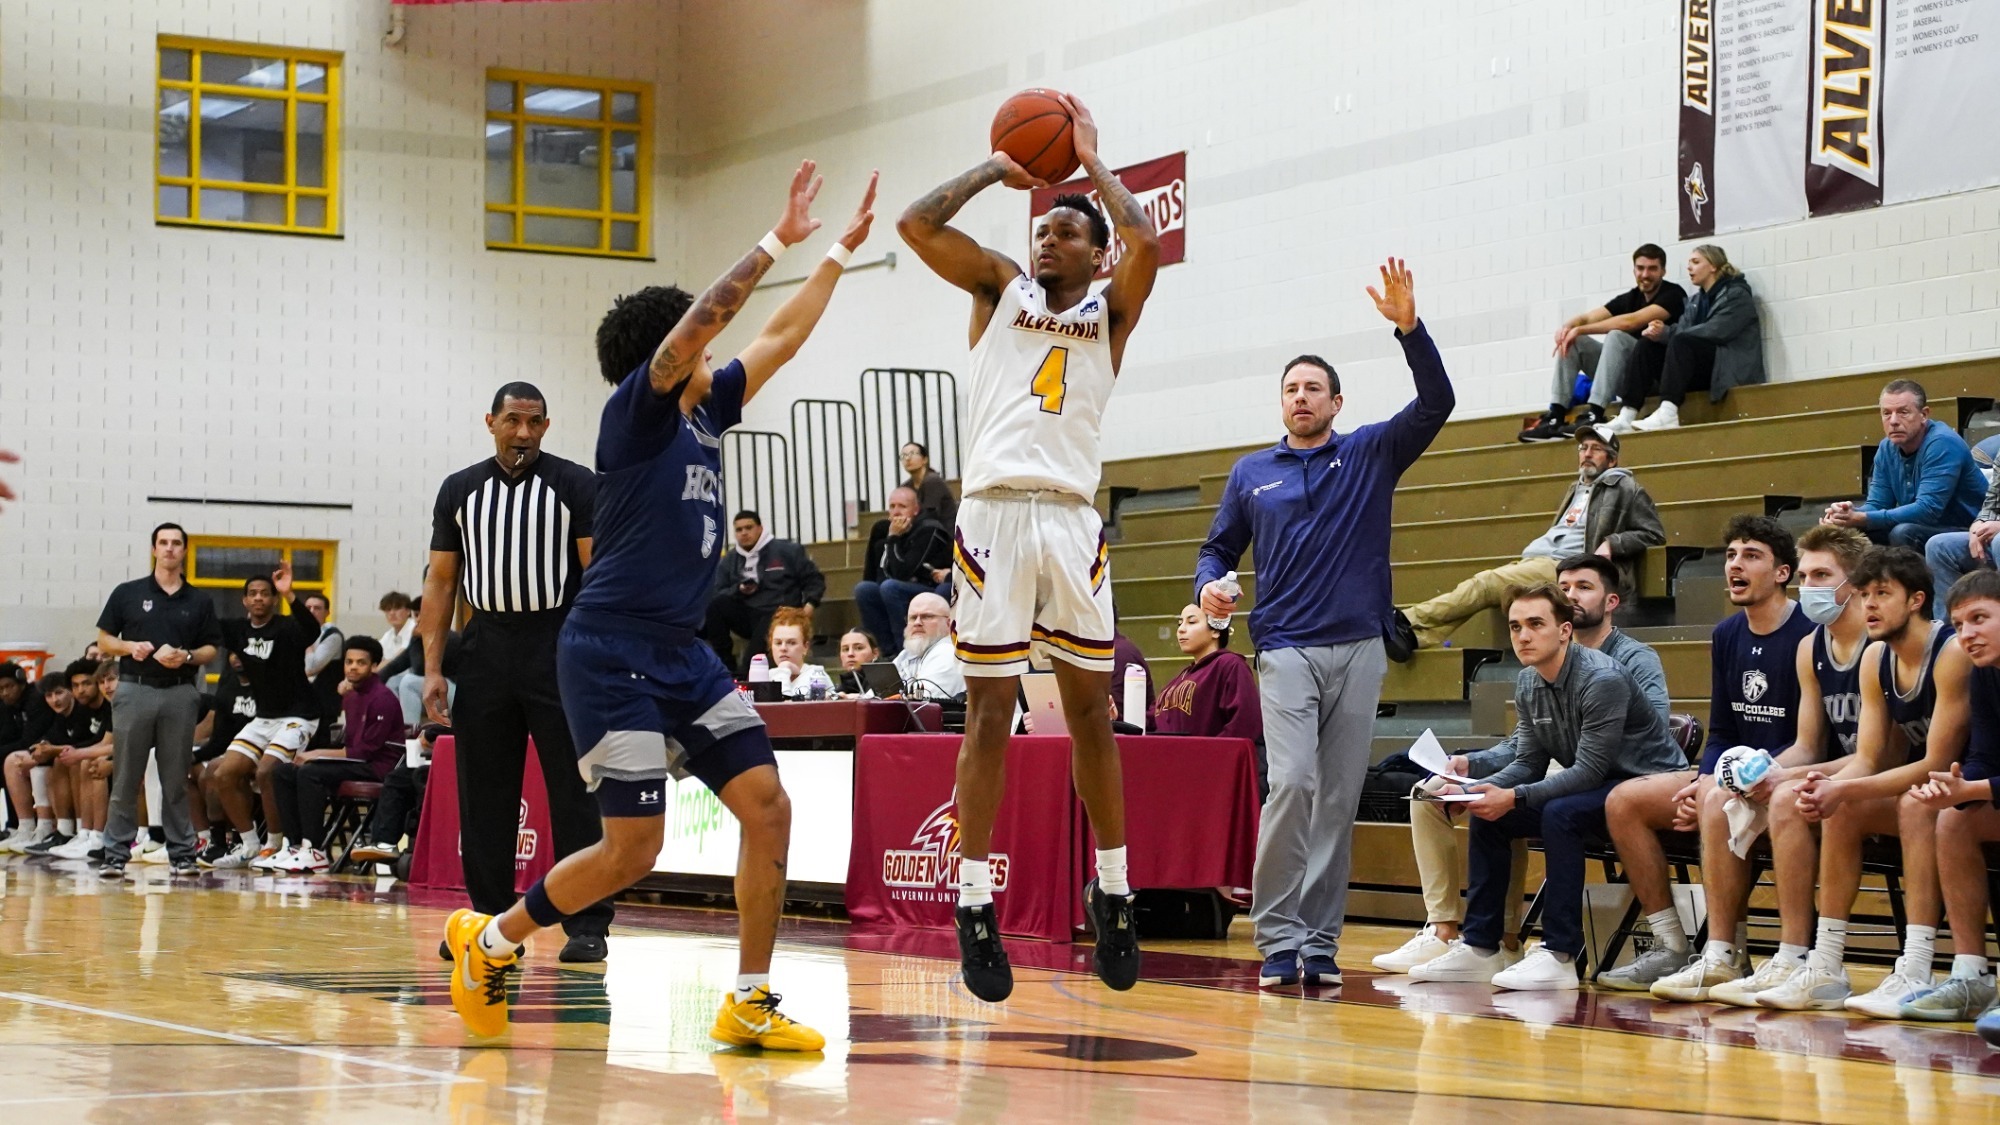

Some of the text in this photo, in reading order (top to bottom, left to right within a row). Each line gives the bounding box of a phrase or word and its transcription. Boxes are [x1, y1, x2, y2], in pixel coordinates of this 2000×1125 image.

[1755, 1, 1786, 14] BASKETBALL
[1913, 1, 1943, 14] WOMEN'S
[1913, 15, 1942, 28] BASEBALL
[1763, 24, 1795, 37] BASKETBALL
[1912, 28, 1943, 41] WOMEN'S
[1944, 24, 1960, 35] GOLF
[1912, 41, 1942, 55] WOMEN'S
[1955, 33, 1979, 45] HOCKEY
[1762, 50, 1794, 63] BASKETBALL
[1737, 71, 1760, 82] BASEBALL
[1736, 85, 1751, 94] FIELD
[1735, 98, 1751, 107] FIELD
[1735, 110, 1753, 120] MEN'S
[1754, 104, 1783, 117] BASKETBALL
[1735, 123, 1753, 132] MEN'S
[1754, 119, 1772, 129] TENNIS
[1011, 308, 1099, 341] ALVERNIA
[1031, 345, 1069, 415] 4
[1745, 704, 1786, 717] COLLEGE
[885, 854, 937, 883] GOLDEN
[891, 890, 935, 902] ALVERNIA
